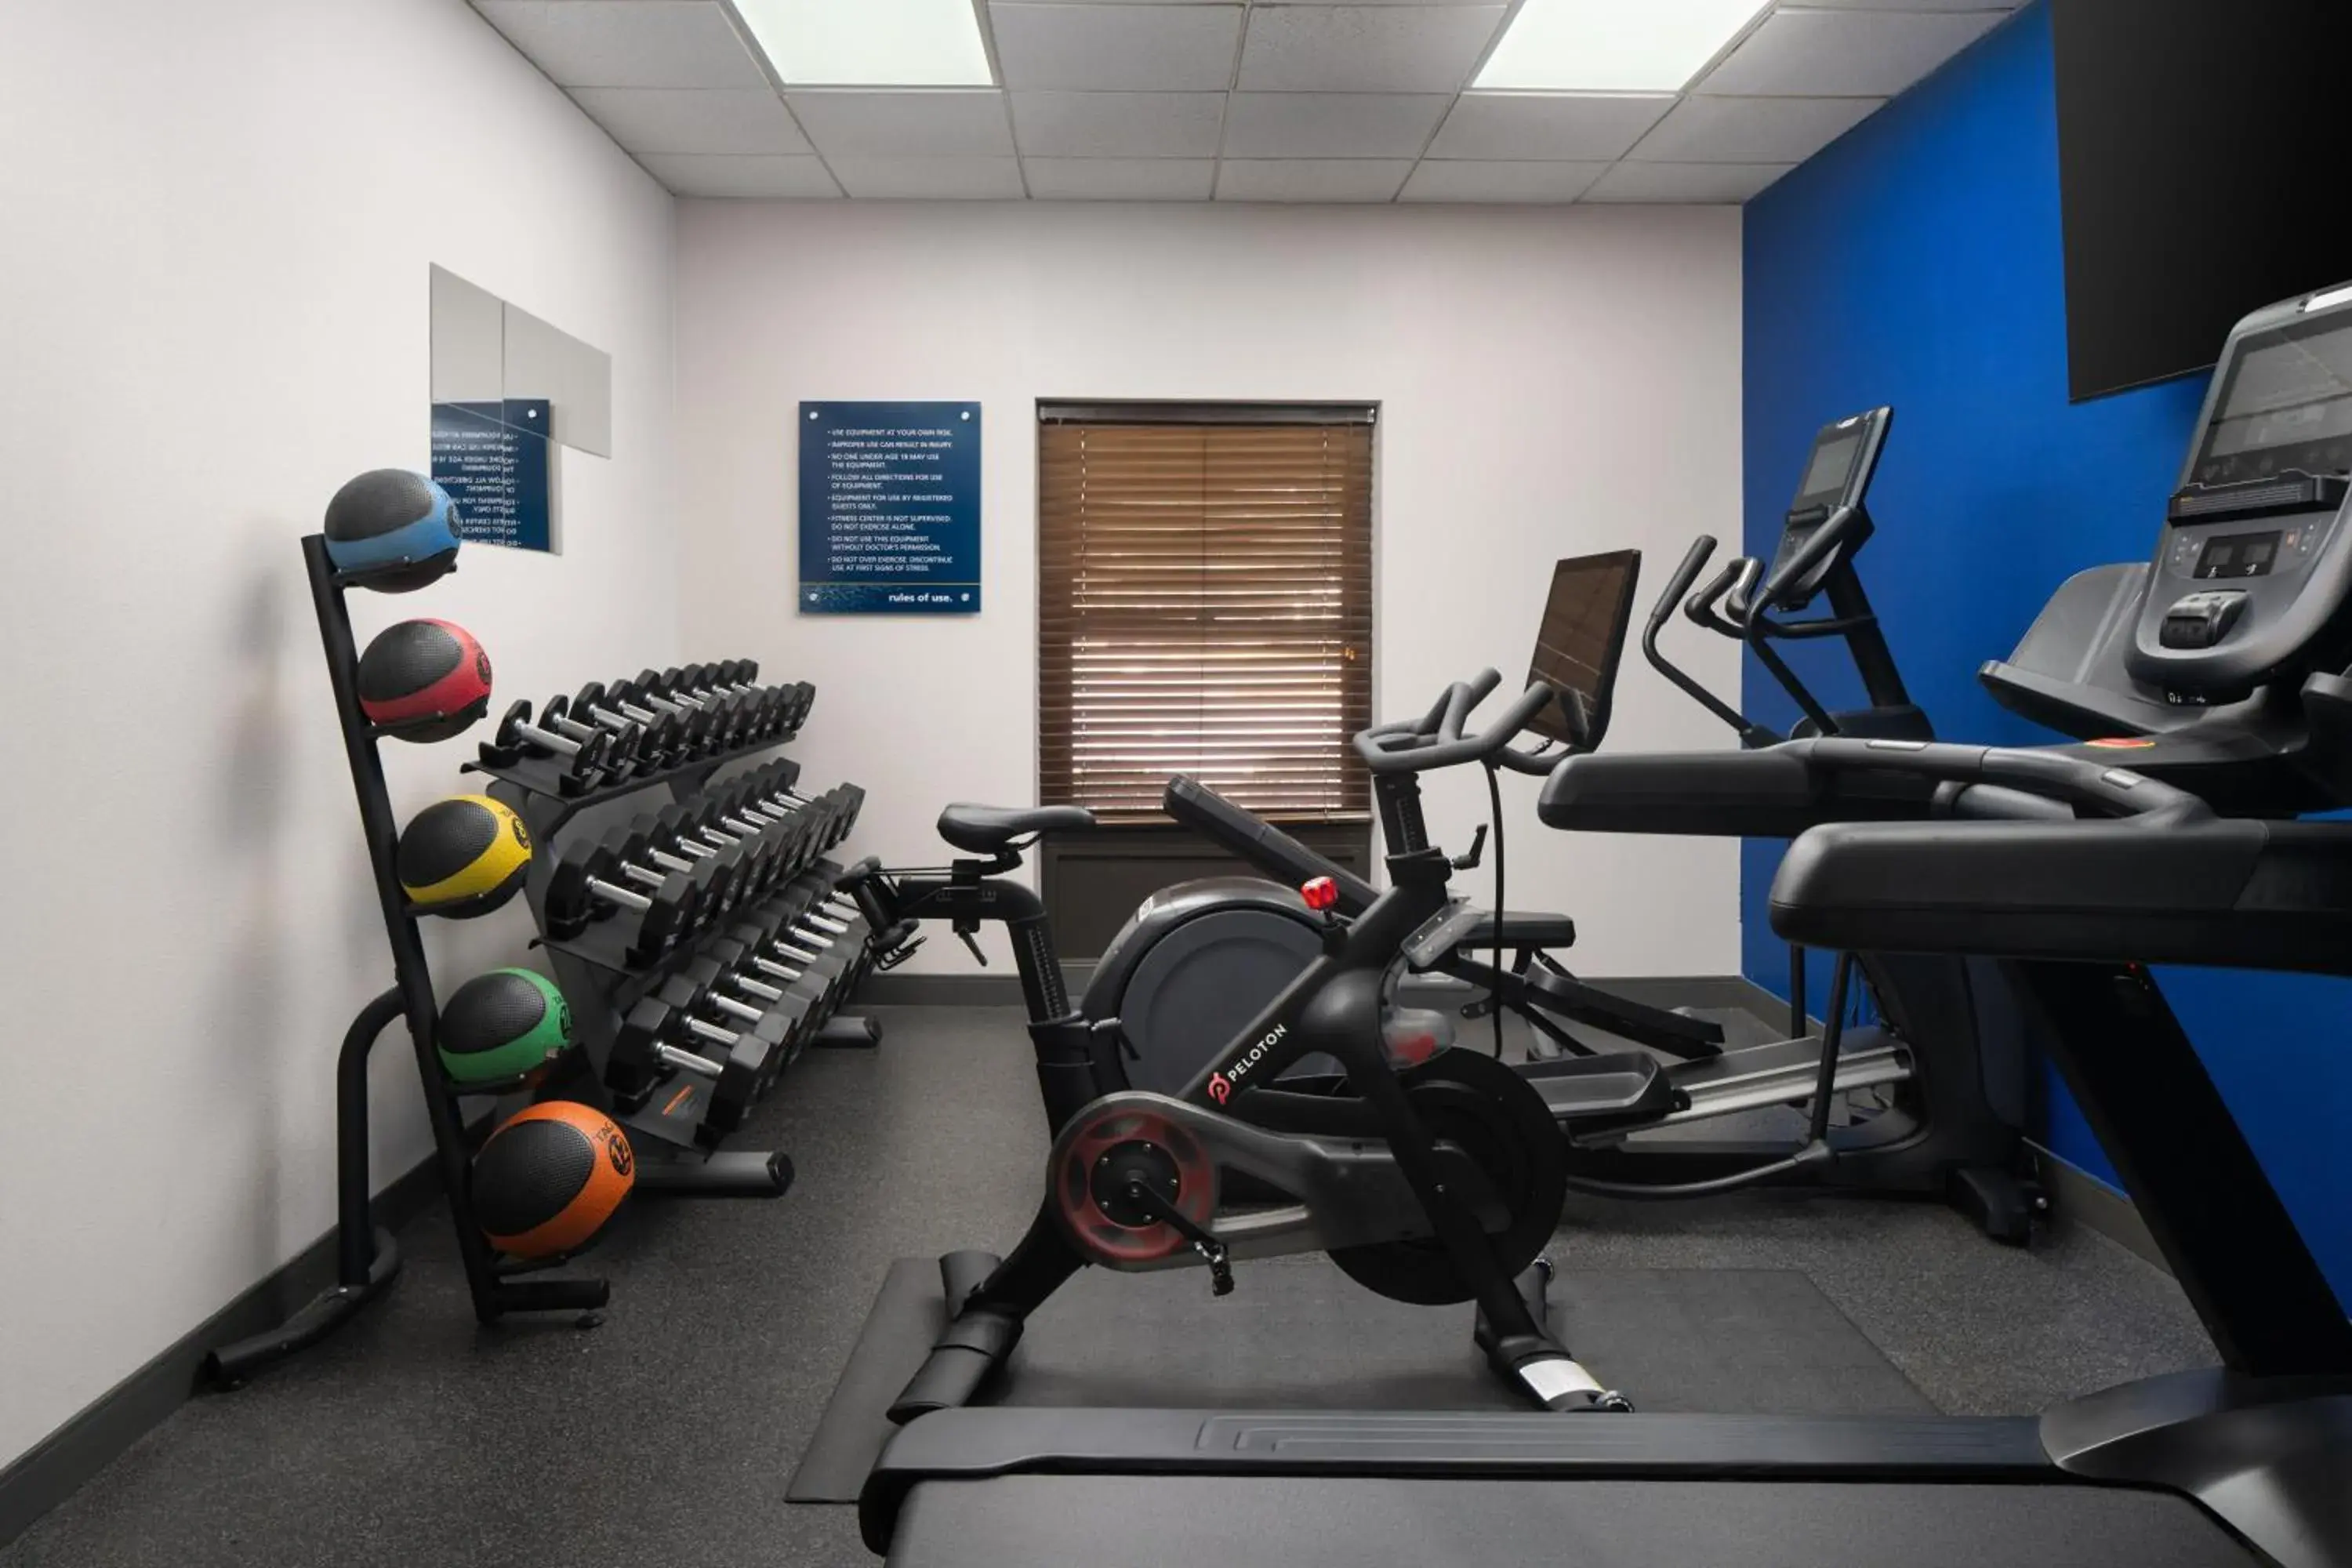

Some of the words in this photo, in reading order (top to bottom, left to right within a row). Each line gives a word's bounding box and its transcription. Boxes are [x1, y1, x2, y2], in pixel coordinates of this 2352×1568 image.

[889, 593, 914, 603] rules
[917, 593, 931, 603] of
[932, 594, 953, 603] use.
[1227, 1023, 1288, 1083] PELOTON
